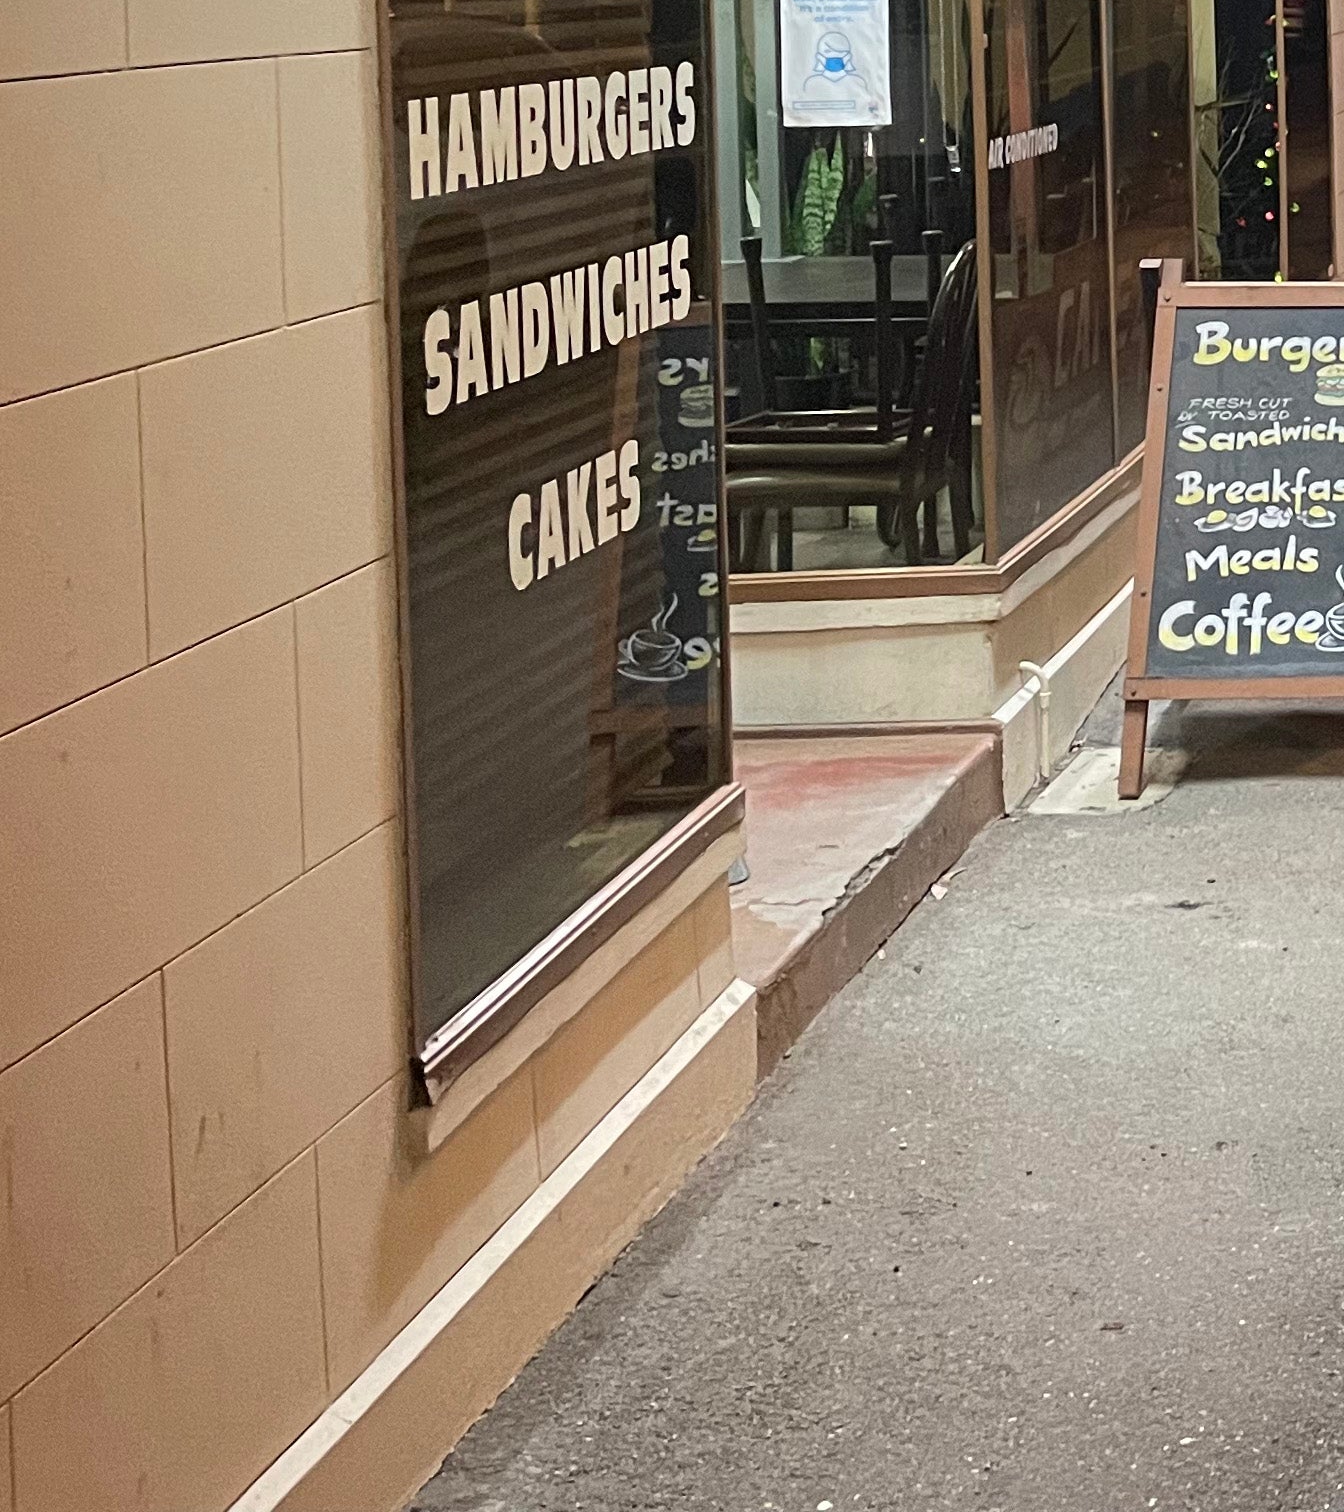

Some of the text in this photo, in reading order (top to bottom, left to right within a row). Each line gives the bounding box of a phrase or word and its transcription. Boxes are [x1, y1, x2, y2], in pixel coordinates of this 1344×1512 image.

[407, 61, 696, 200] HAMBURGERS
[988, 136, 1004, 170] AIR
[425, 234, 692, 416] SANDWICHES
[1188, 397, 1293, 410] FRESH CUT
[1207, 409, 1291, 421] TOASTED
[509, 439, 640, 591] CAKES
[1185, 534, 1320, 583] Meals
[1158, 591, 1325, 656] Coffee
